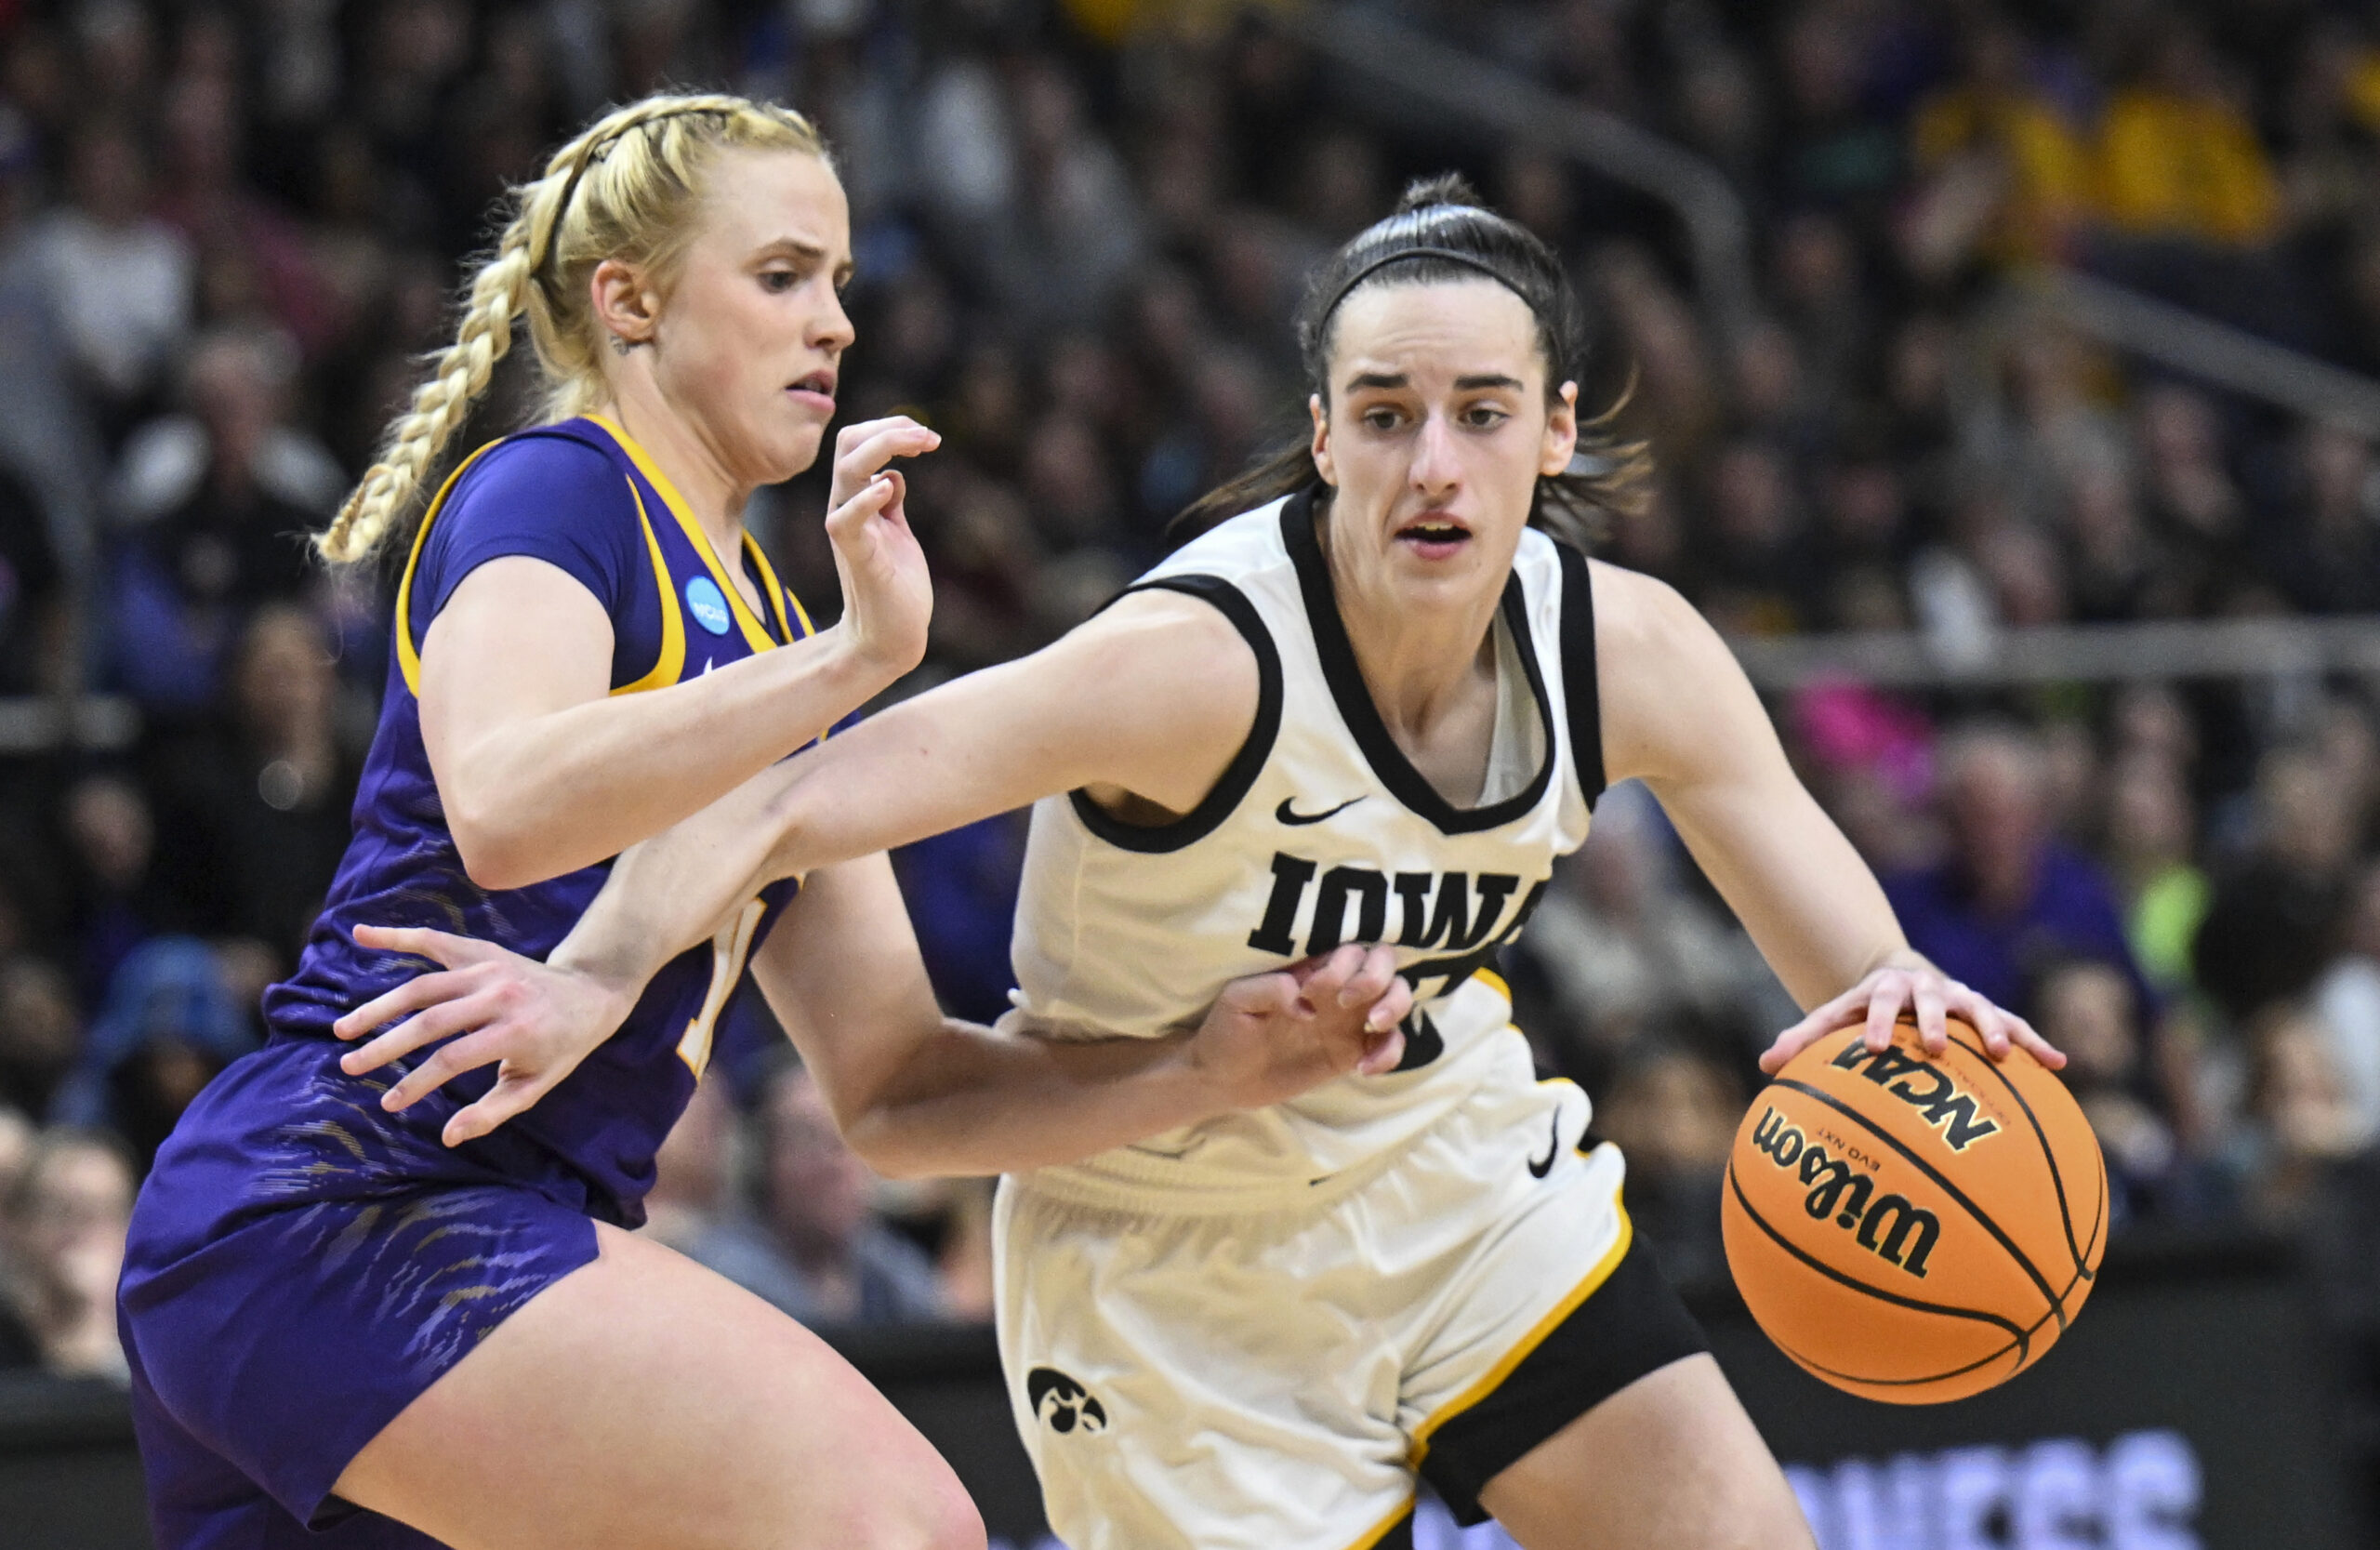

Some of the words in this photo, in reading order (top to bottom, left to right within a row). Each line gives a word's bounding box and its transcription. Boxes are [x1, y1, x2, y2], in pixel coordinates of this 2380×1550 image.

[1815, 1126, 1847, 1151] NXT
[1846, 1146, 1882, 1172] EVO
[1752, 1105, 1941, 1279] Wilson
